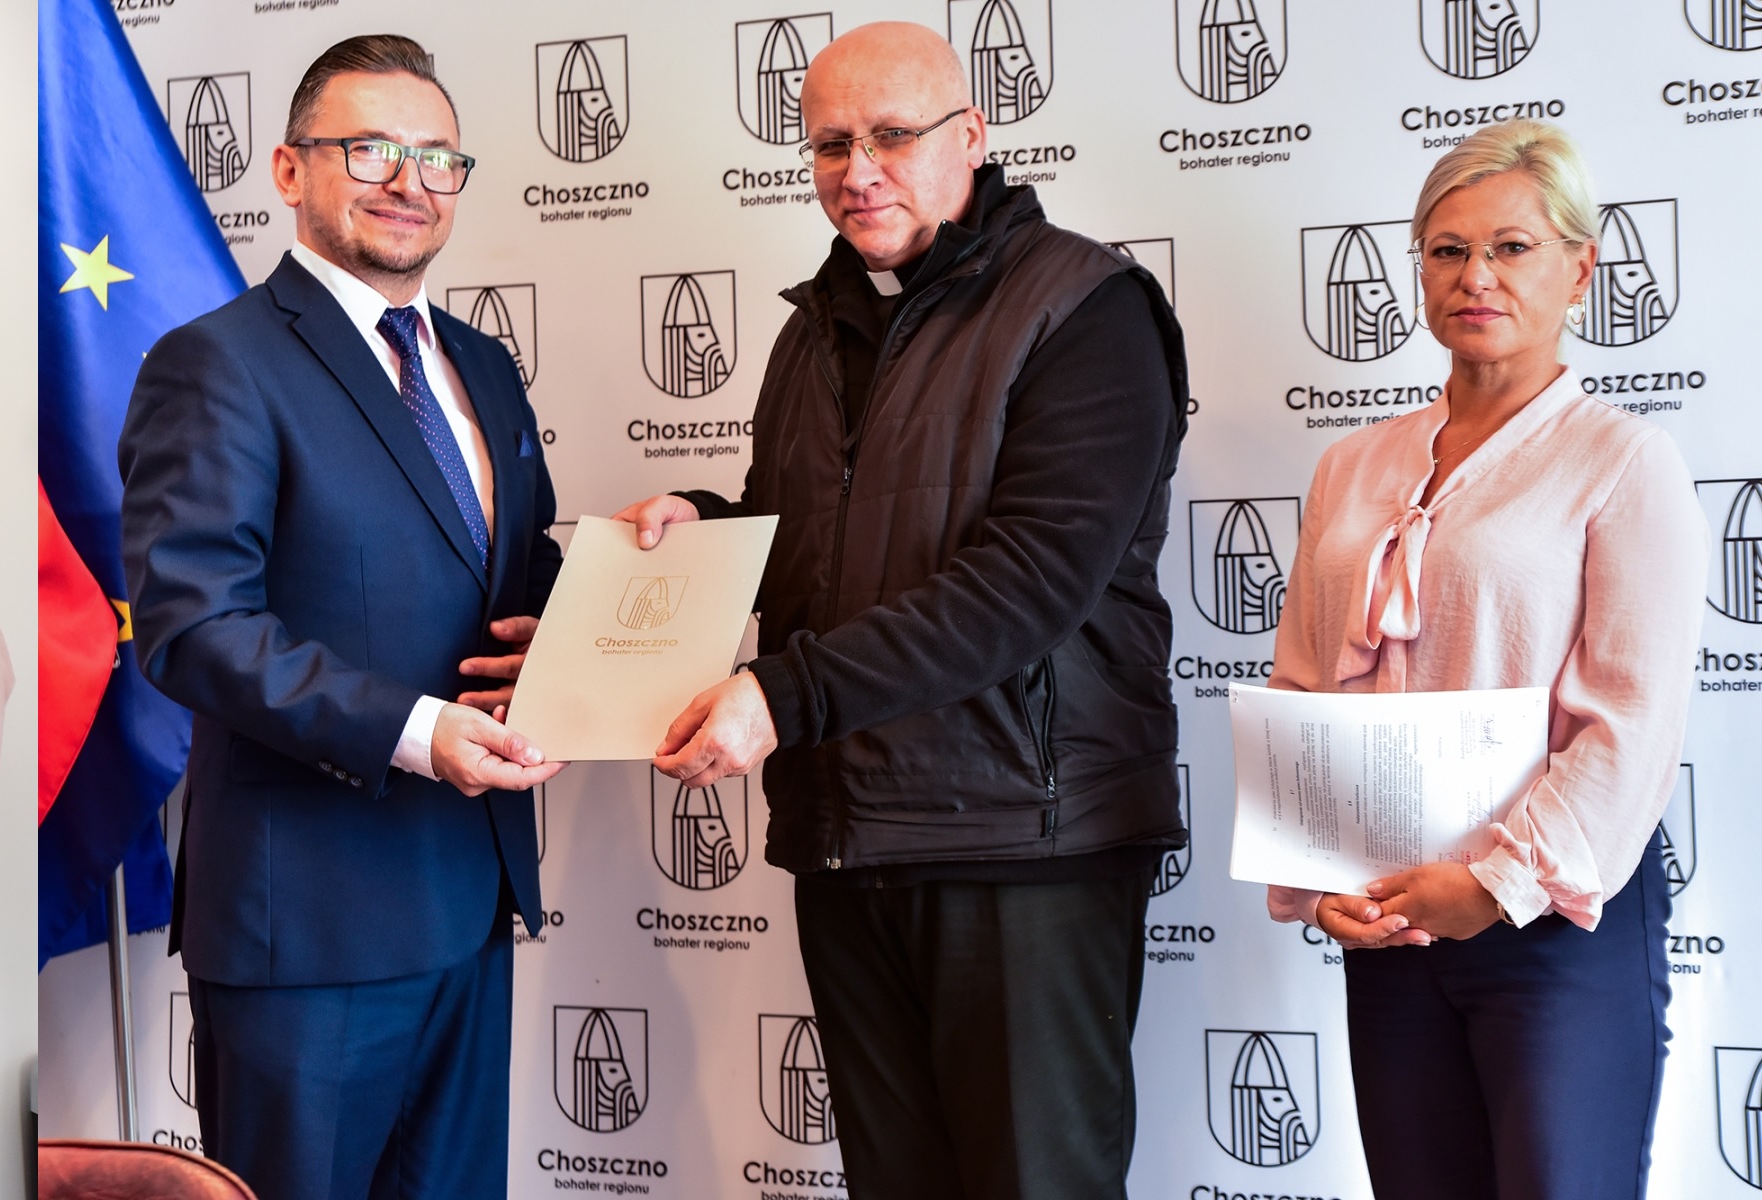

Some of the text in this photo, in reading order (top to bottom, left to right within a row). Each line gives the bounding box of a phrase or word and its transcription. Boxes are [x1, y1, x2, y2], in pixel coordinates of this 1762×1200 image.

[1662, 79, 1762, 106] Chosz
[1401, 99, 1566, 131] Choszczno
[1686, 107, 1749, 124] bohater
[1159, 123, 1312, 153] Choszczno
[983, 144, 1076, 166] szczno
[1180, 151, 1290, 170] bohater regionu
[723, 168, 811, 190] Choszc
[1007, 171, 1056, 185] regionu
[524, 182, 649, 206] Choszczno
[740, 190, 819, 207] bohater regio
[540, 206, 632, 222] bohater regionu
[1581, 370, 1706, 395] oszczno
[627, 419, 754, 441] Choszczno
[1307, 415, 1362, 428] bohater
[644, 444, 739, 458] bohater regionu
[595, 637, 678, 647] Choszczno
[1175, 656, 1274, 679] Choszc
[636, 908, 769, 932] Choszczno
[654, 936, 750, 952] bohater regionu
[1146, 949, 1195, 963] egionu
[538, 1149, 668, 1178] Choszczno
[743, 1161, 847, 1188] Choszcz
[554, 1177, 650, 1195] bohater regionu
